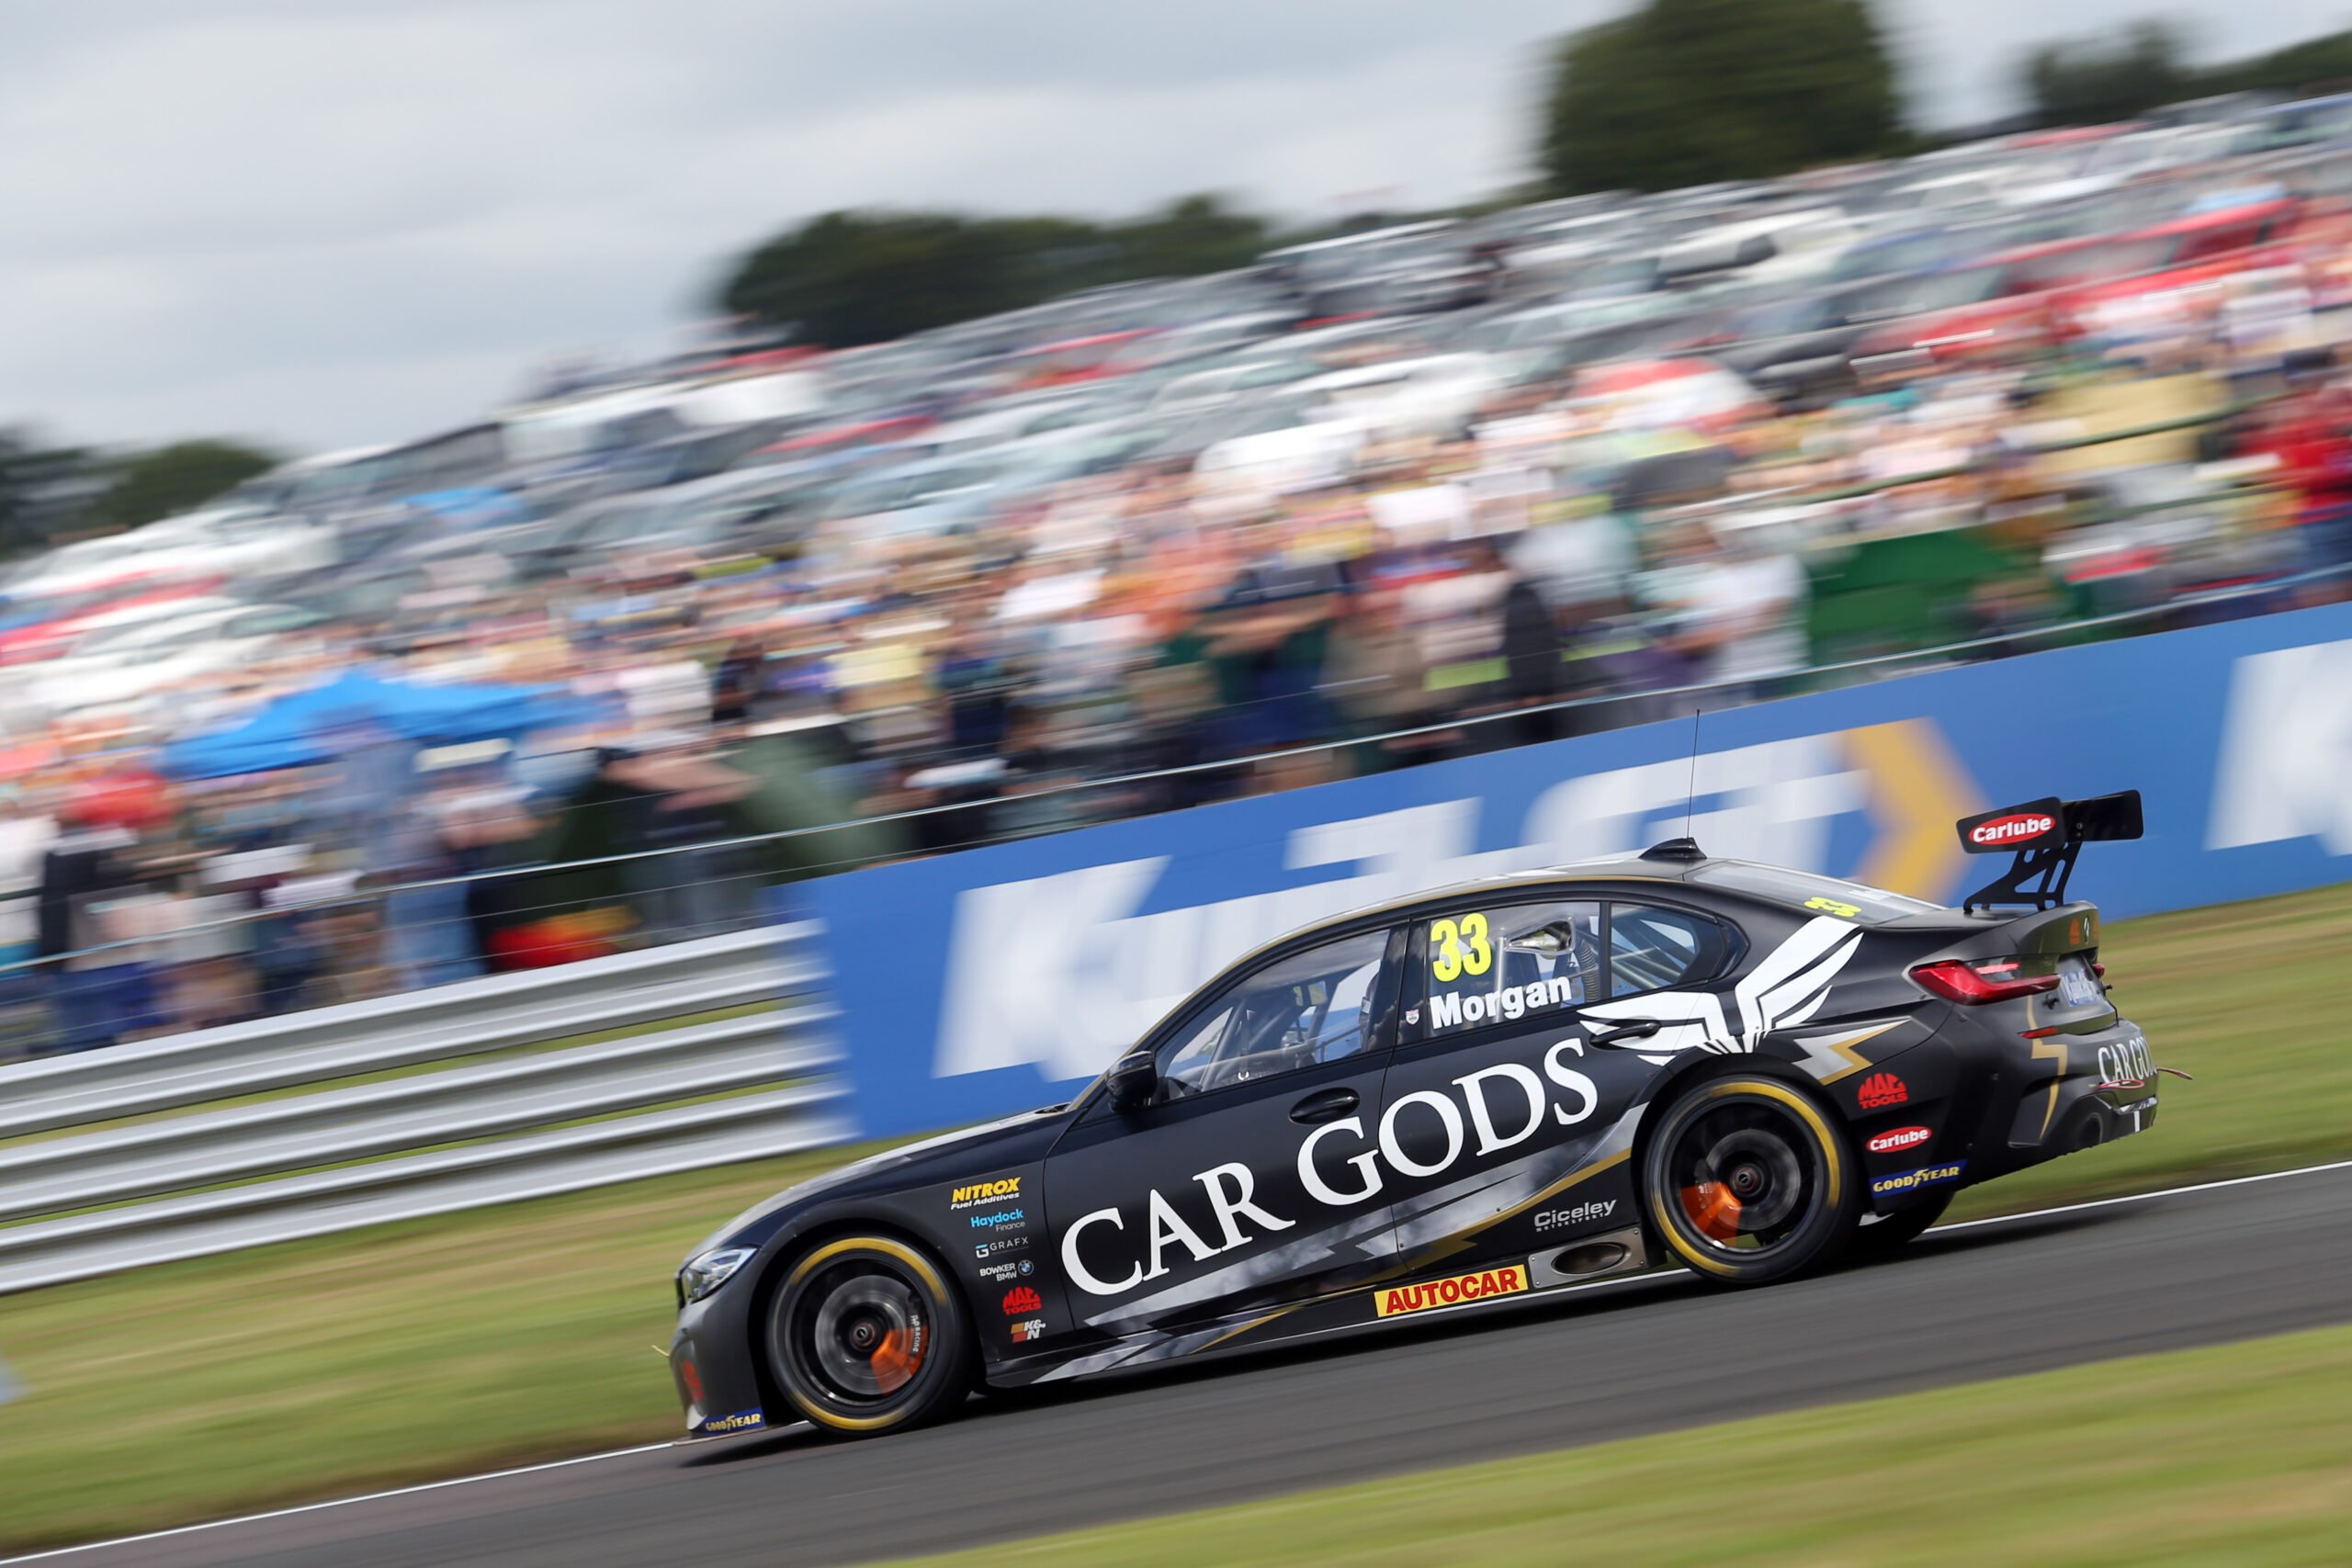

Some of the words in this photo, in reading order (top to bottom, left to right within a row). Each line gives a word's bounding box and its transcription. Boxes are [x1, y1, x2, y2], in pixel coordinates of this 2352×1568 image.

[1973, 817, 2052, 843] Carlube
[1430, 912, 1492, 983] 33
[1429, 975, 1572, 1030] Morgan
[2098, 1043, 2135, 1088] CAR
[1858, 1073, 1907, 1100] MAC
[1859, 1092, 1909, 1110] TOOLS
[1869, 1129, 1929, 1151] Carlube
[1060, 1162, 1296, 1296] CAR
[1296, 1037, 1599, 1206] GODS
[952, 1177, 1022, 1203] NITROX
[1872, 1166, 1961, 1192] GOODYEAR
[950, 1200, 973, 1211] Fuel
[973, 1192, 1021, 1206] Additives
[1533, 1199, 1617, 1227] Ciceley
[970, 1208, 1024, 1227] Haydock
[995, 1221, 1026, 1232] Finance
[989, 1236, 1029, 1251] GRAFX
[979, 1262, 1016, 1277] BOWKER
[996, 1270, 1017, 1281] BMW
[1002, 1286, 1041, 1308] MAC
[1385, 1268, 1520, 1314] AUTOCAR
[1003, 1302, 1043, 1315] TOOLS
